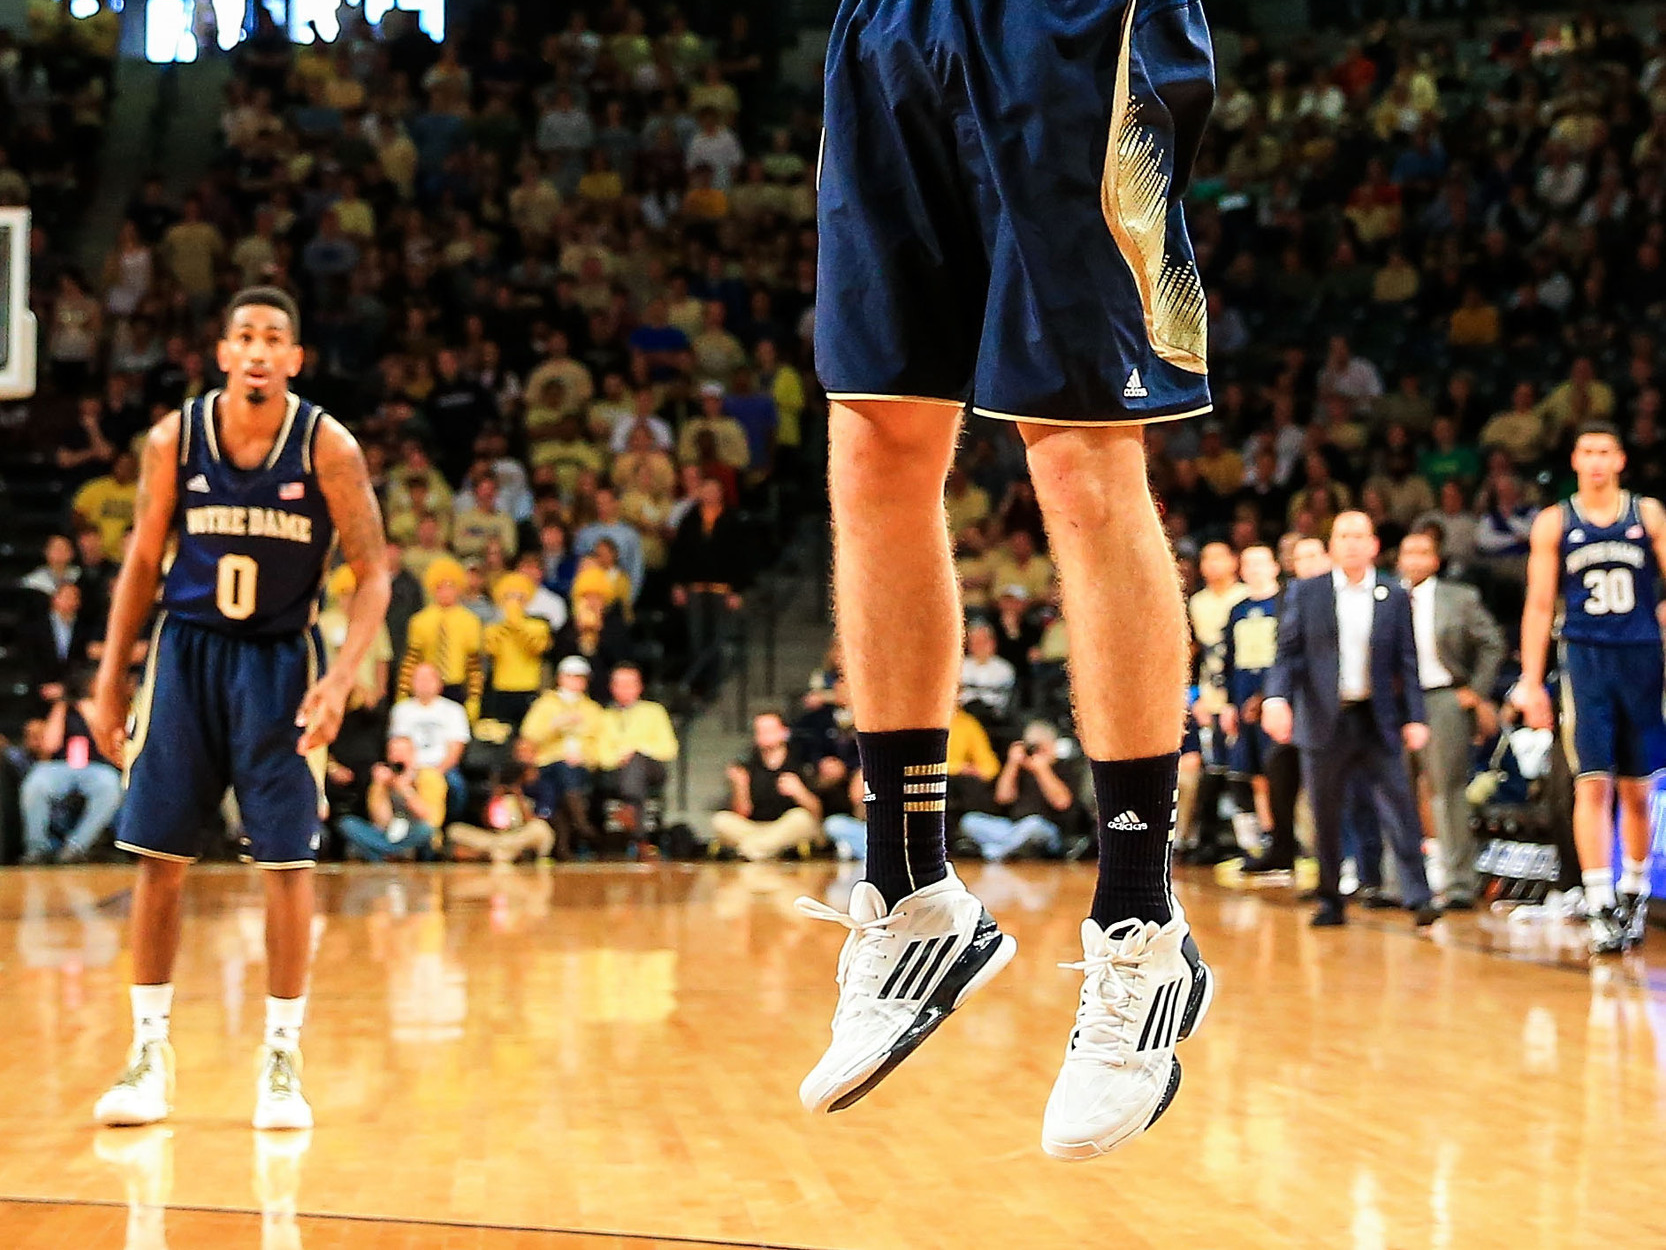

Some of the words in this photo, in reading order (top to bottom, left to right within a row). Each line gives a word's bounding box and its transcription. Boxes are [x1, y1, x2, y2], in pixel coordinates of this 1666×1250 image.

[216, 552, 259, 620] 0
[1583, 566, 1636, 616] 30
[1107, 819, 1149, 831] adidas
